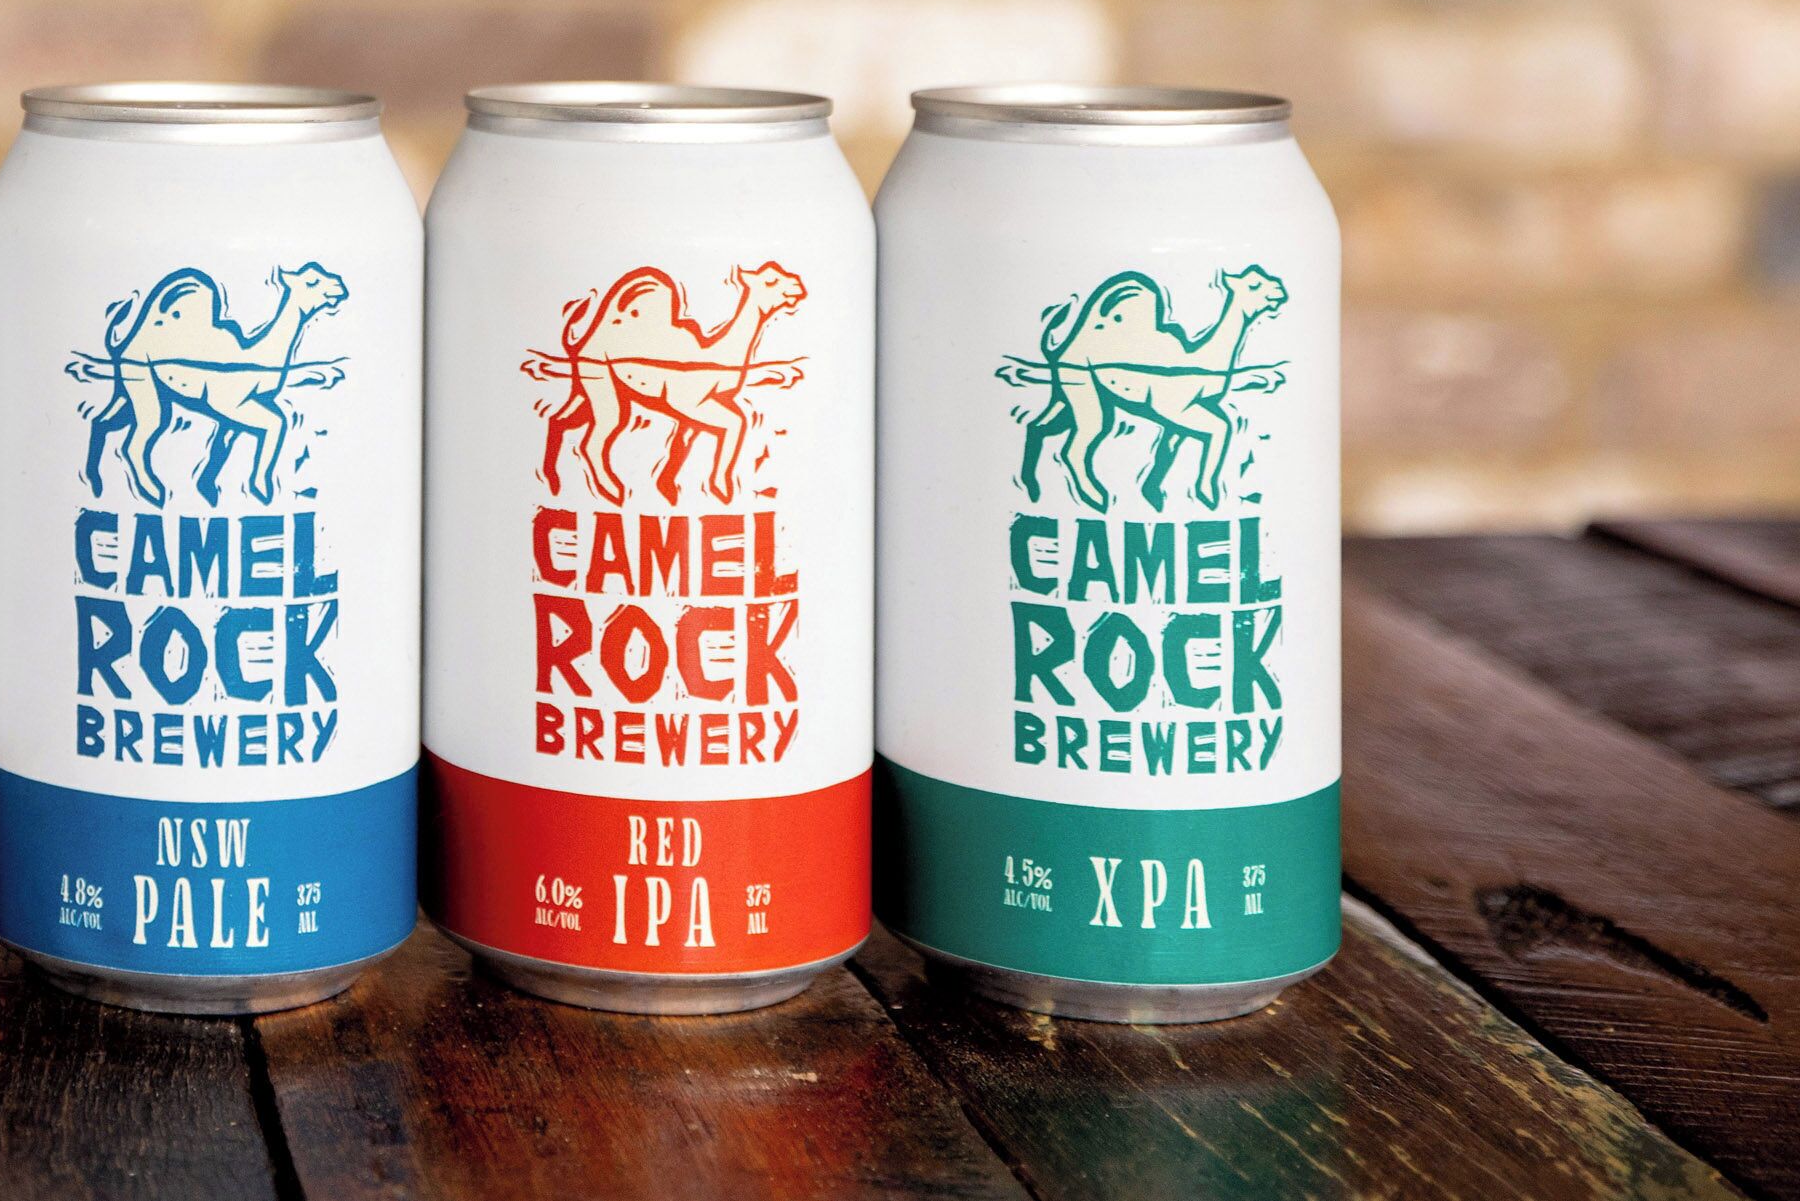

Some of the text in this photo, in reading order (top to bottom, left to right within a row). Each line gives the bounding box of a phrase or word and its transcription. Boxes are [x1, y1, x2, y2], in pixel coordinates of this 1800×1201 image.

[74, 506, 338, 598] CAMEL
[532, 504, 799, 597] CAMEL
[1009, 512, 1282, 605] CAMEL
[75, 596, 338, 706] ROCK
[533, 594, 799, 706] ROCK
[1011, 602, 1283, 714] ROCK
[77, 704, 338, 768] BREWERY
[536, 702, 799, 767] BREWERY
[1015, 711, 1283, 776] BREWERY
[156, 816, 251, 868] NSW
[628, 815, 702, 866] RED
[60, 874, 104, 909] 4.8%
[297, 882, 321, 906] 375
[535, 874, 583, 910] 6.0%
[746, 884, 771, 907] 375
[1004, 855, 1053, 890] 4.5%
[1089, 856, 1212, 929] XPA
[1243, 865, 1266, 888] 375
[59, 905, 103, 931] ALC/VOL
[133, 875, 270, 948] PALE
[298, 909, 318, 934] ML
[535, 906, 581, 932] ALC/VOL
[612, 875, 715, 947] IPA
[747, 911, 768, 934] ML
[1003, 888, 1053, 913] ALC/VOL
[1244, 892, 1264, 915] ML
